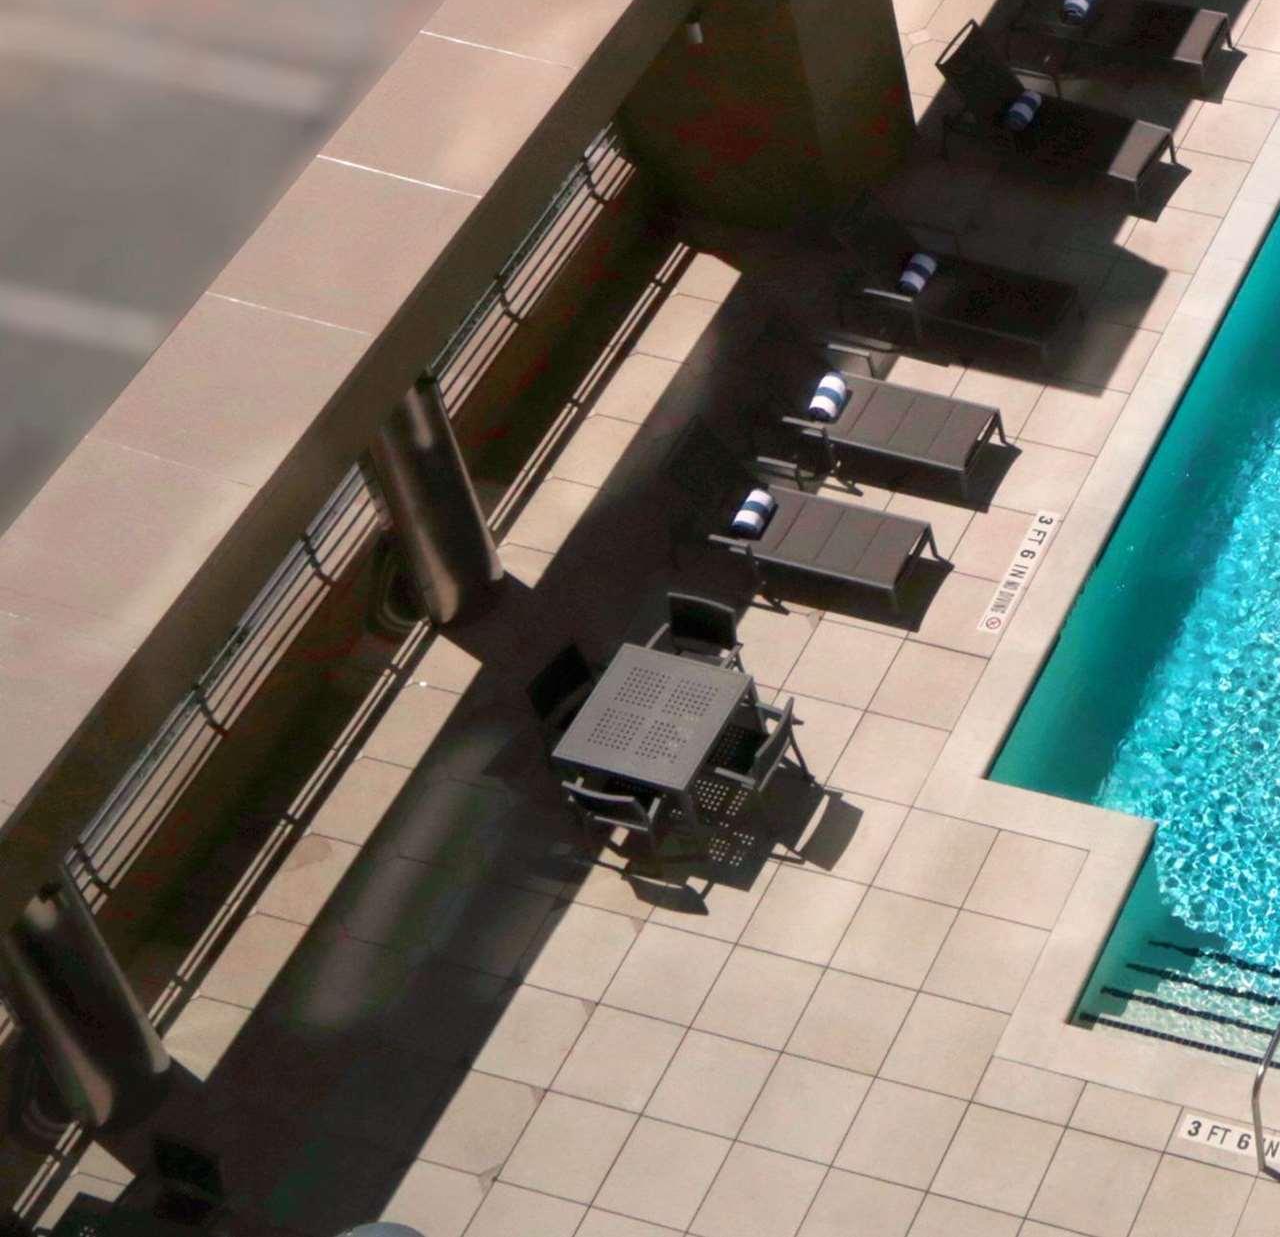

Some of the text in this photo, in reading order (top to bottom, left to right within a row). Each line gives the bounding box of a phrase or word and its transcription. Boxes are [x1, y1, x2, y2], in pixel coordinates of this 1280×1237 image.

[1038, 516, 1053, 525] 3
[1028, 528, 1047, 546] FT
[1020, 549, 1036, 560] 6
[1009, 564, 1028, 579] IN
[1187, 1120, 1203, 1137] 3
[1206, 1125, 1232, 1145] FT
[1236, 1133, 1251, 1150] 6
